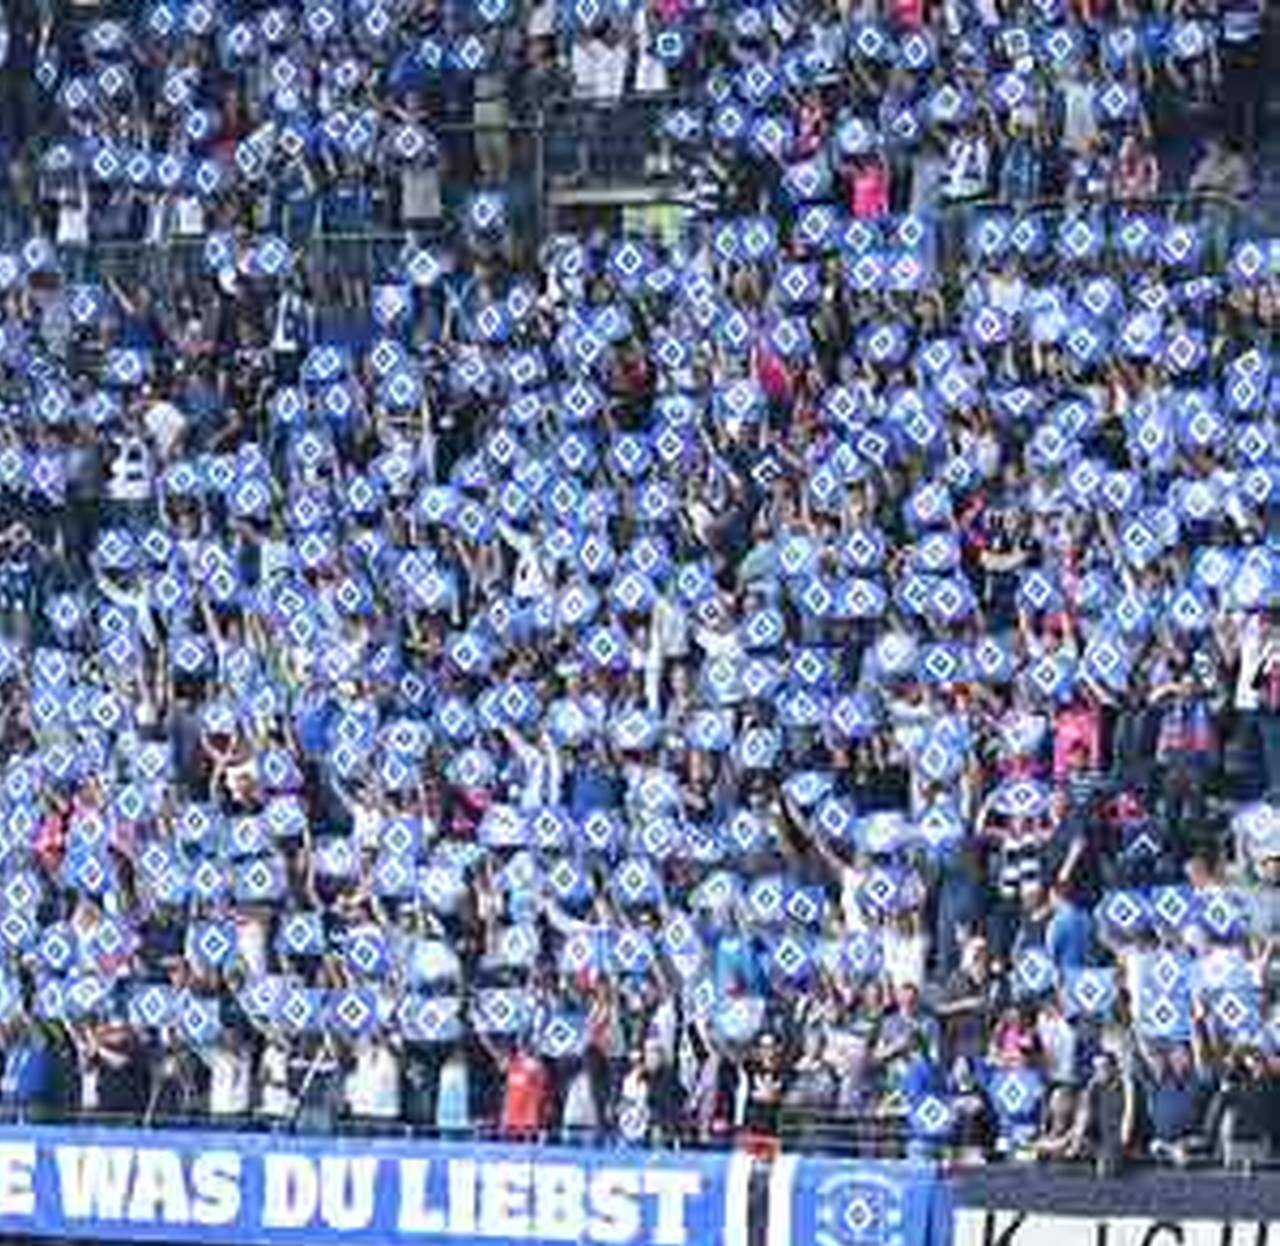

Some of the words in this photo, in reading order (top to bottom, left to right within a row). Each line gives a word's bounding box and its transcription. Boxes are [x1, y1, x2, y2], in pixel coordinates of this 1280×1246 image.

[57, 1145, 240, 1226] WAS
[261, 1152, 377, 1229] DU
[397, 1155, 702, 1246] LIEBST
